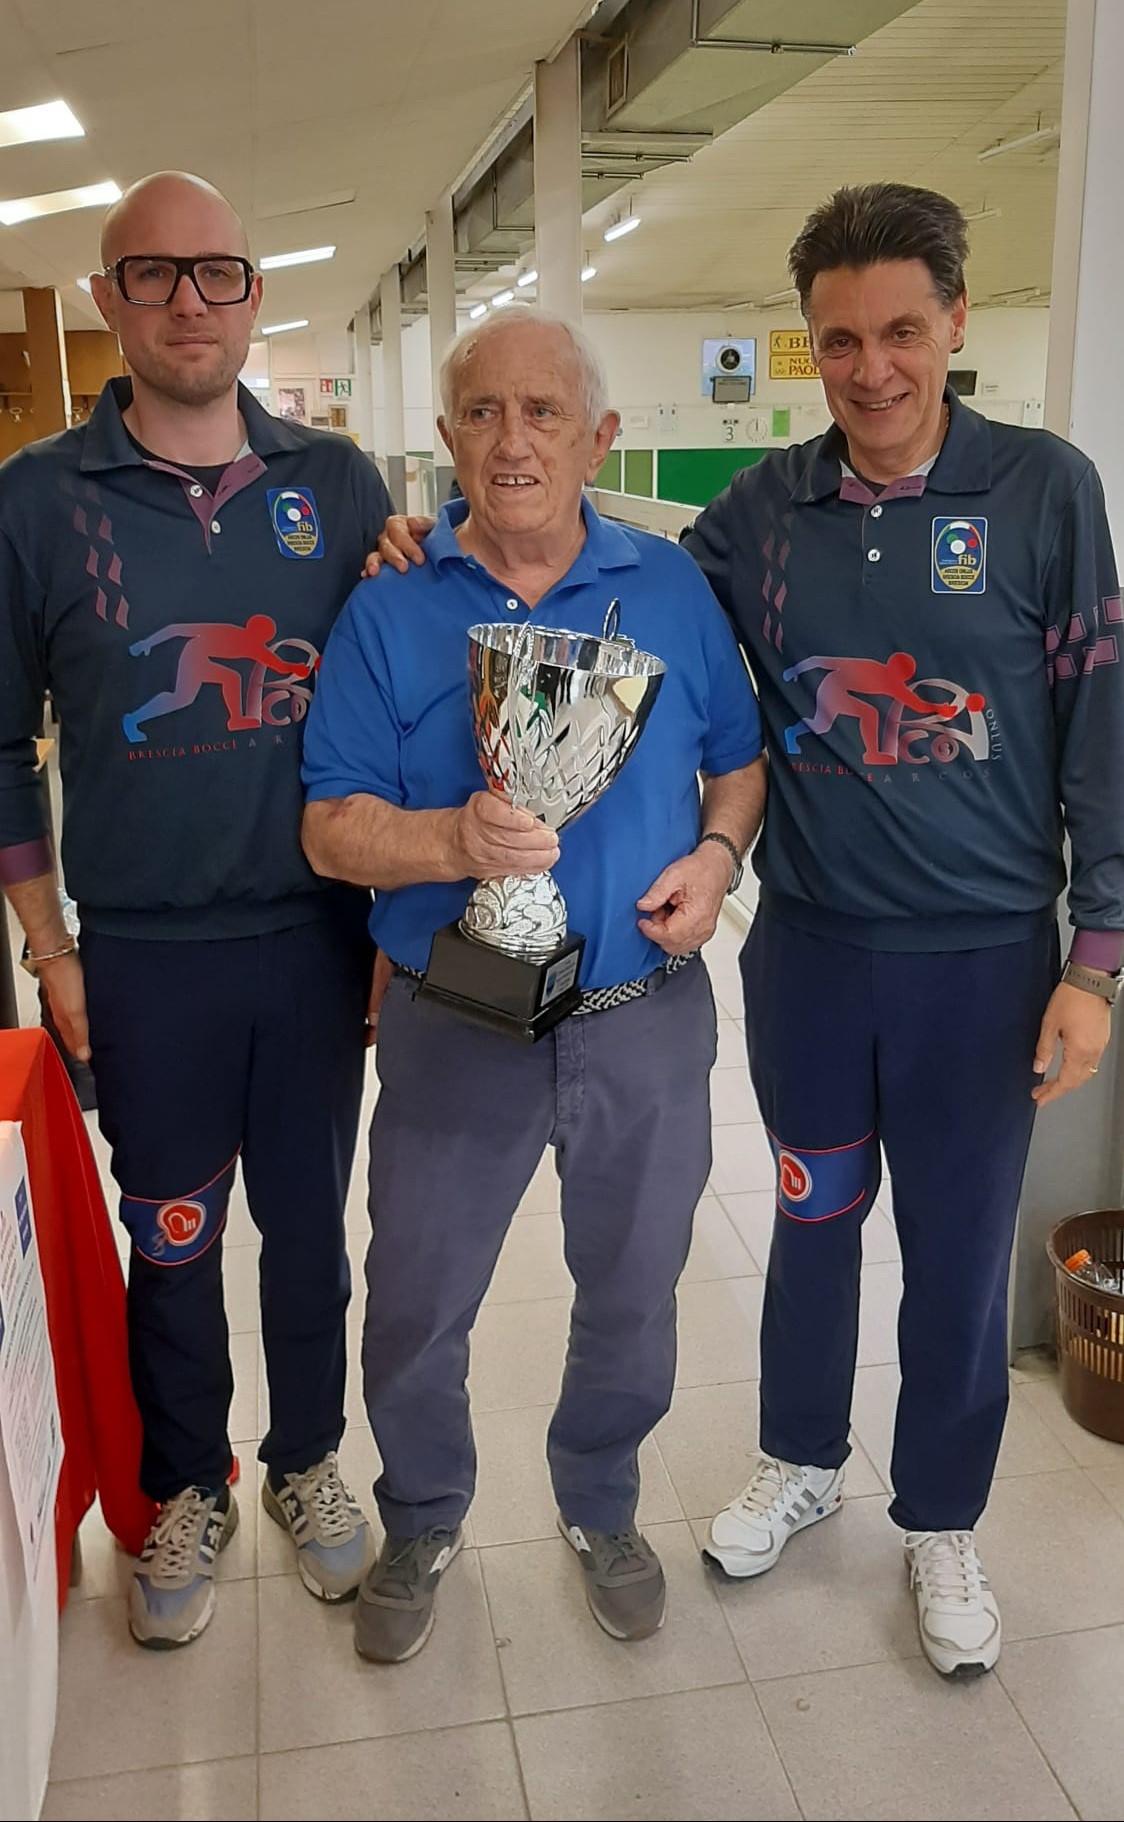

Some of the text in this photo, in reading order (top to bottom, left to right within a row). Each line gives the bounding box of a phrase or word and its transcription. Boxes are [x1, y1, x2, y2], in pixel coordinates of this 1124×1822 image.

[725, 426, 734, 441] 3
[297, 521, 313, 531] fib
[958, 554, 977, 566] fib
[986, 708, 1002, 760] ONLUS
[128, 747, 187, 761] BRESCIA
